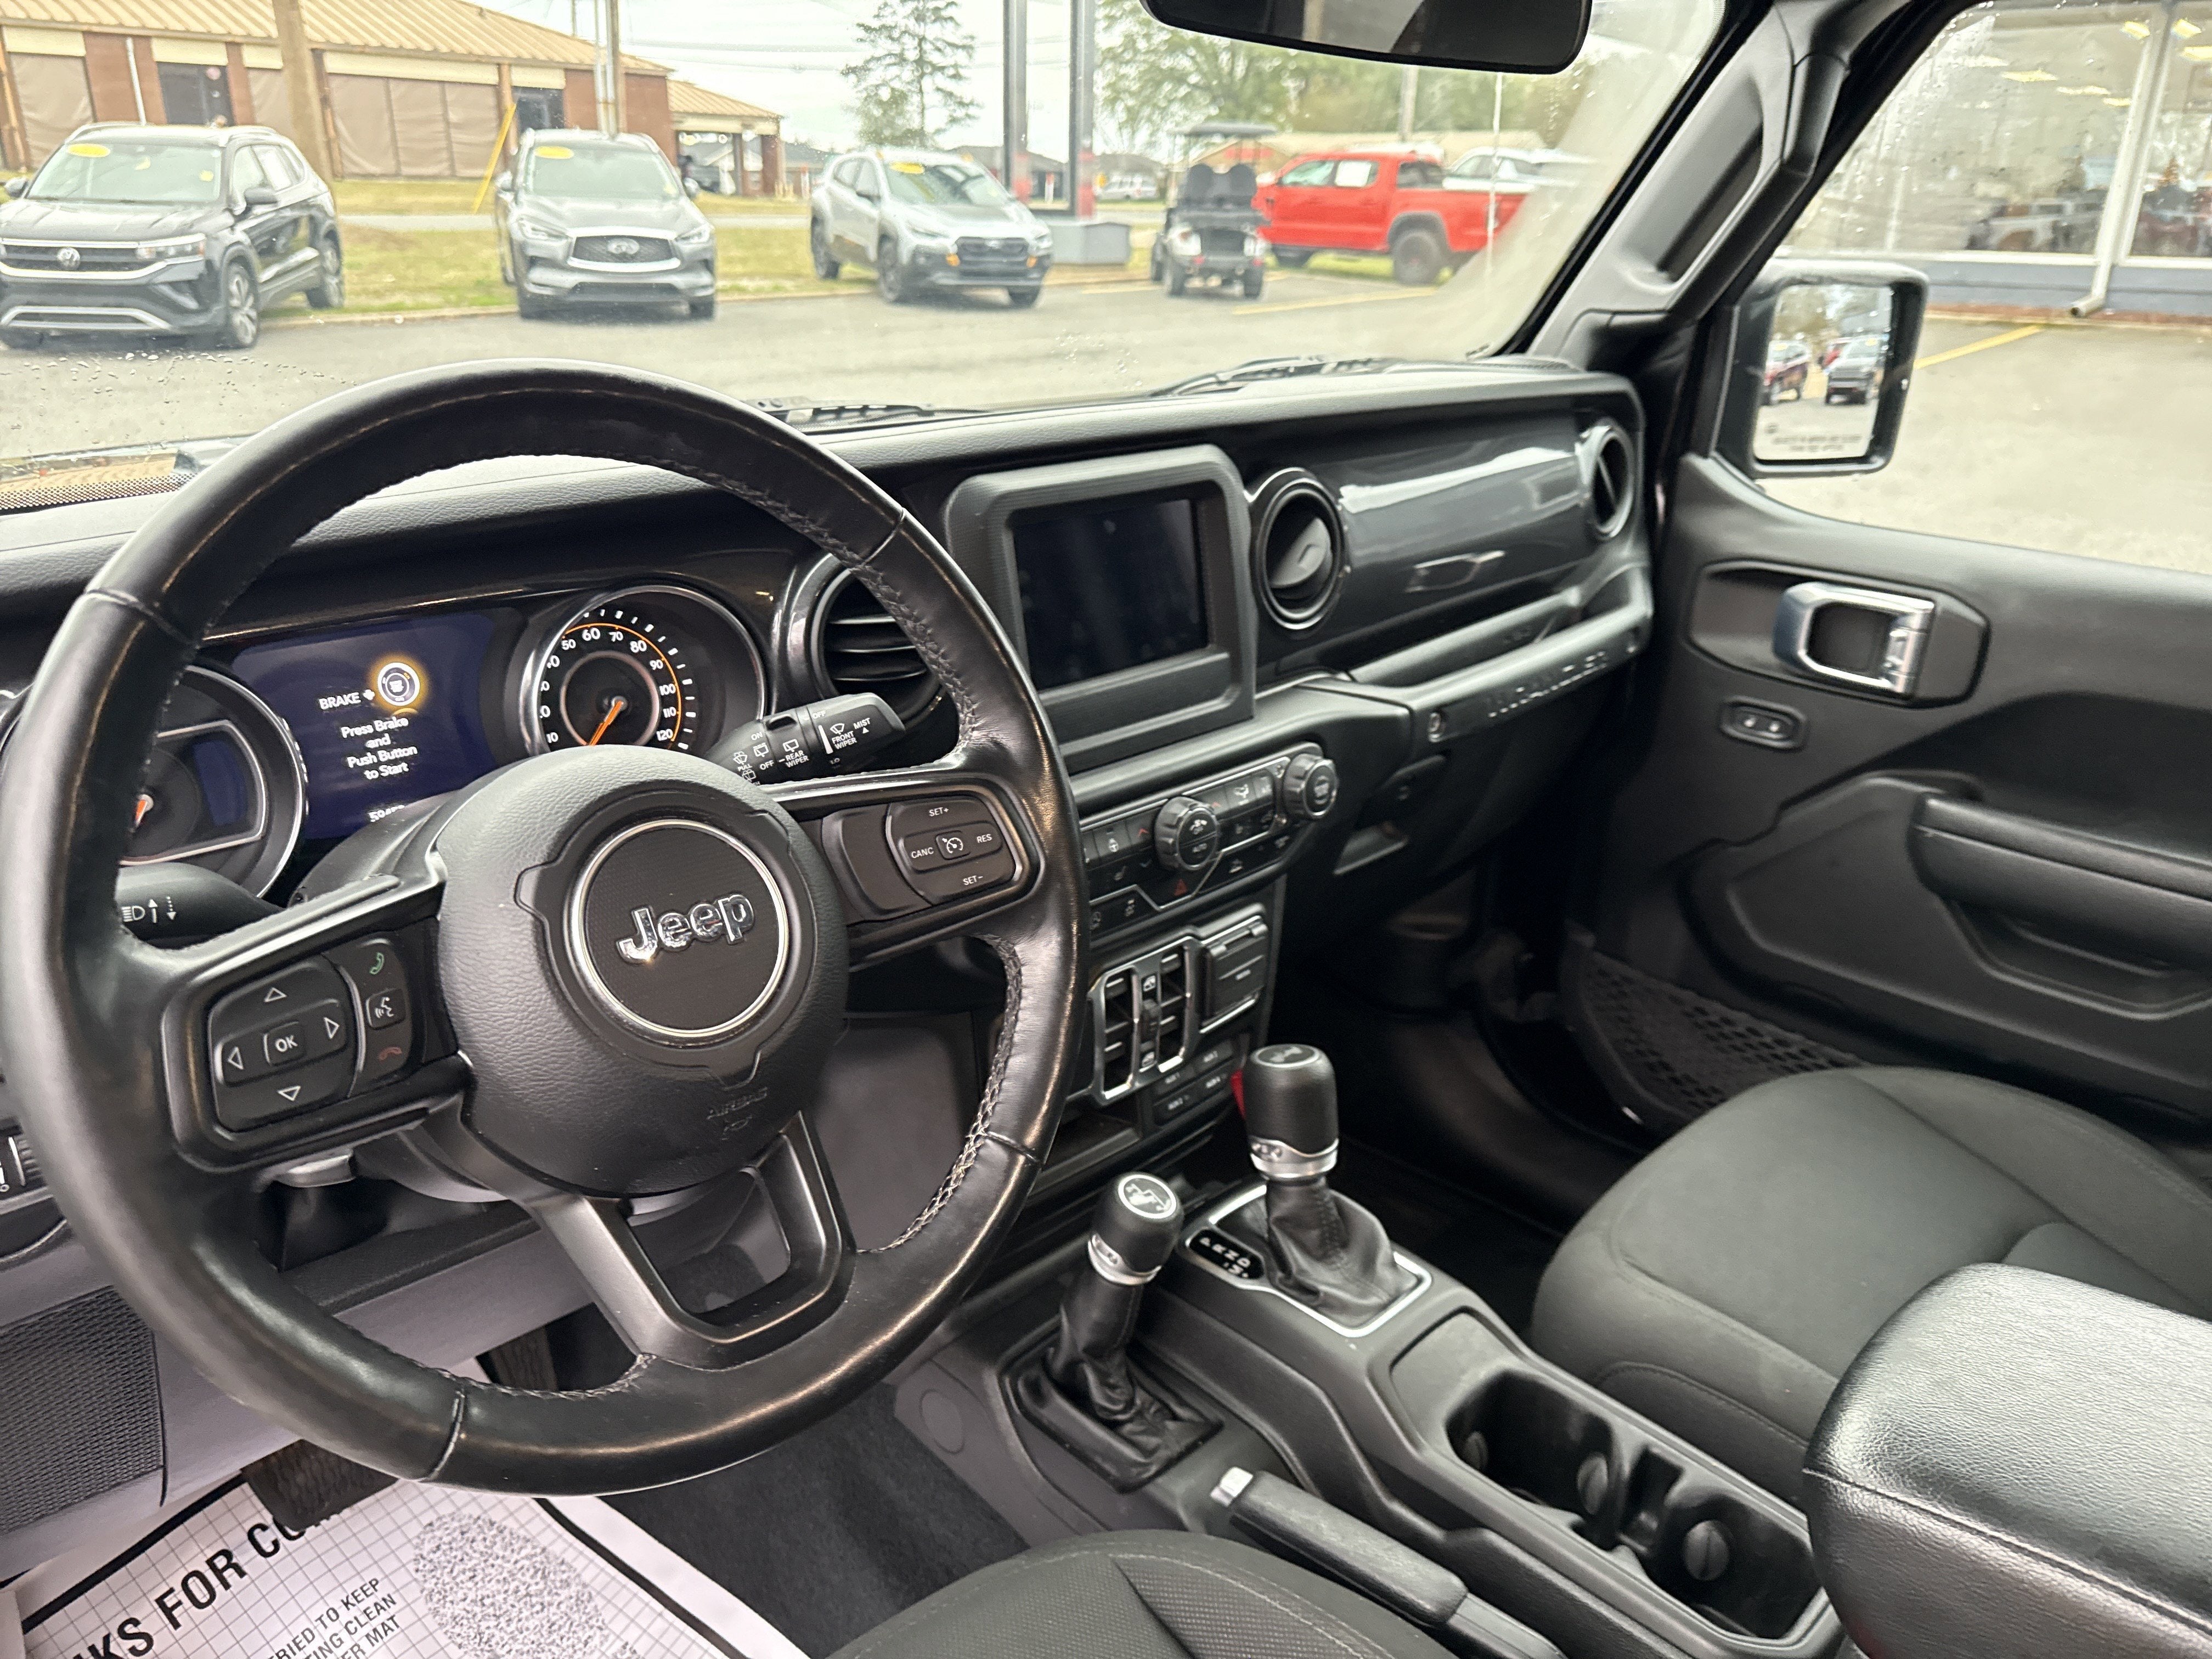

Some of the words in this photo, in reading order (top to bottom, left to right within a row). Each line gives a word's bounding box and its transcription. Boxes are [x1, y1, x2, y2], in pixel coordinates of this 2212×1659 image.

[582, 628, 601, 641] 60
[608, 631, 623, 642] 70
[561, 639, 576, 650] 50
[630, 640, 647, 653] 80
[650, 659, 663, 670] 90
[659, 683, 676, 695] 100
[319, 692, 361, 709] BRAKE
[663, 707, 677, 718] 110
[812, 710, 826, 719] OFF
[341, 724, 374, 738] Press
[374, 716, 409, 731] Brake
[853, 717, 871, 730] MIST
[364, 733, 391, 748] and
[546, 732, 558, 743] 10
[656, 729, 673, 741] 120
[751, 731, 763, 741] ON
[831, 730, 855, 744] FRONT
[834, 737, 857, 749] WIPER
[347, 752, 377, 768] Push
[377, 746, 418, 761] Button
[785, 749, 805, 761] REAR
[786, 755, 809, 768] WIPER
[363, 770, 379, 780] to
[379, 762, 409, 776] Start
[759, 760, 775, 770] OFF
[929, 807, 949, 817] SET+
[977, 833, 993, 843] RES
[911, 847, 934, 859] CANC
[616, 893, 756, 964] Jeep
[275, 1035, 298, 1052] OK
[154, 1548, 247, 1630] FOR
[315, 1607, 340, 1630] TO
[341, 1578, 379, 1611] KEEP
[344, 1593, 397, 1635] CLEAN
[365, 1614, 400, 1647] MAT
